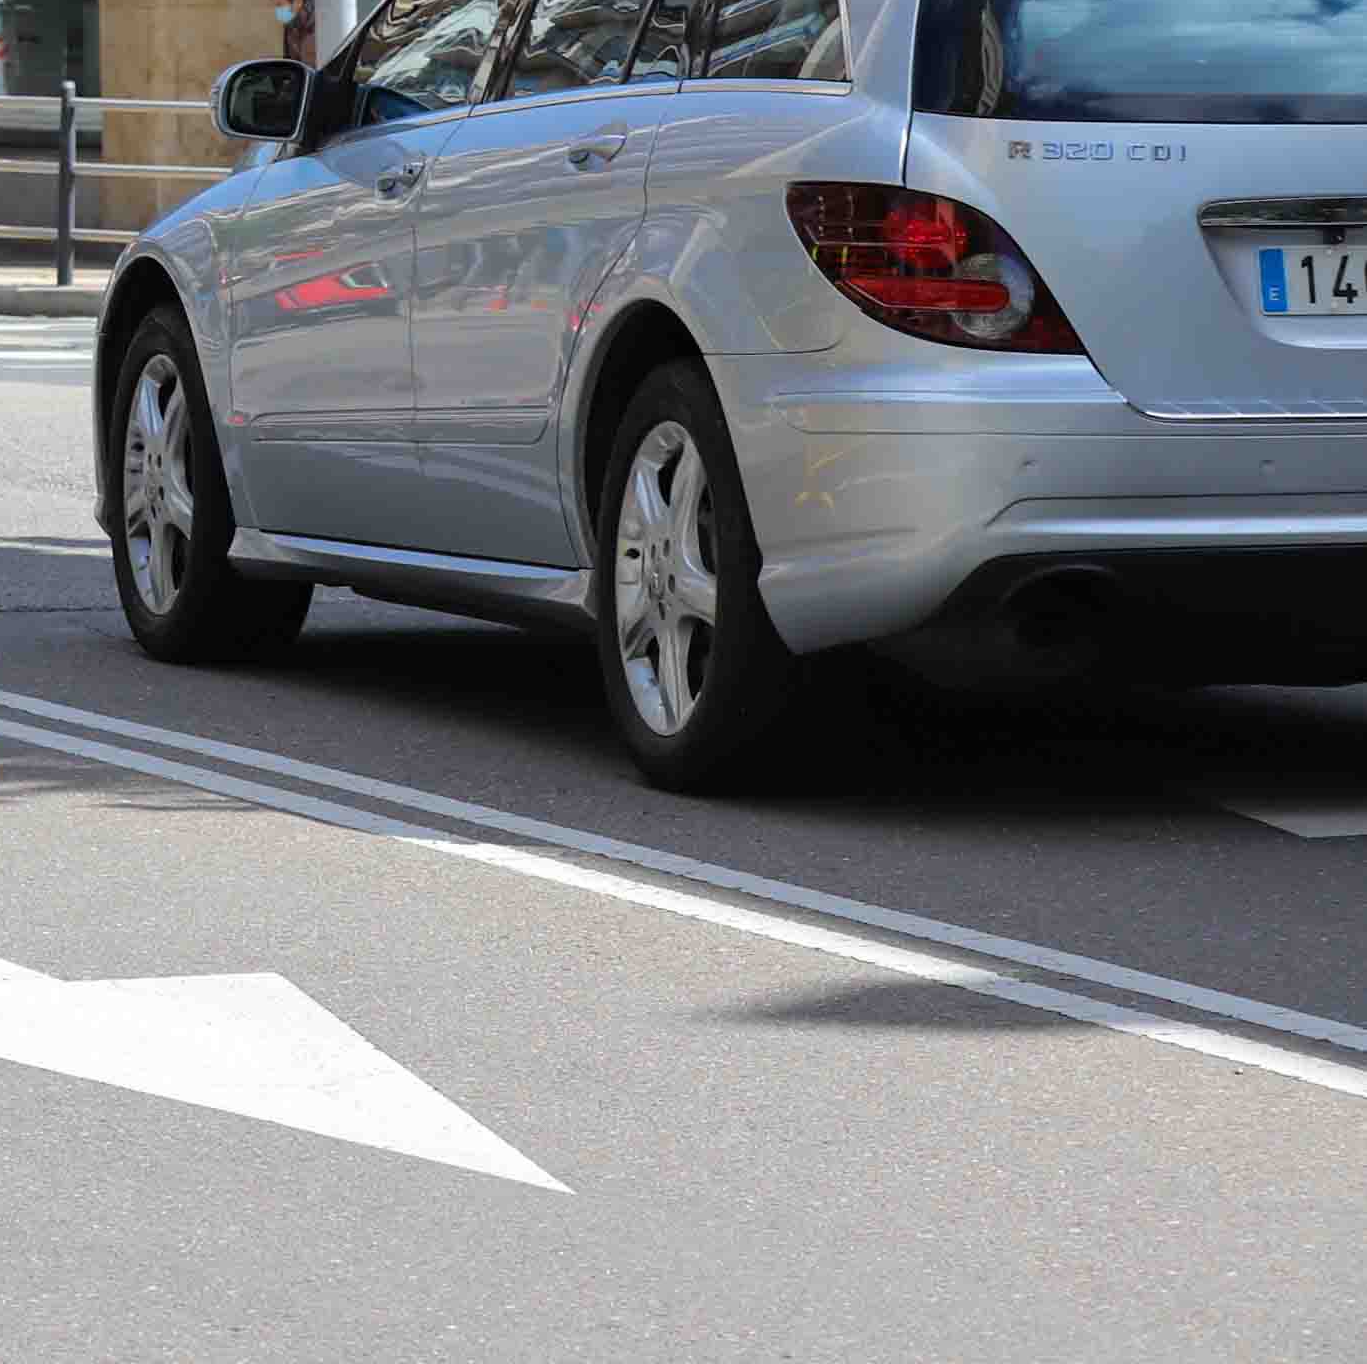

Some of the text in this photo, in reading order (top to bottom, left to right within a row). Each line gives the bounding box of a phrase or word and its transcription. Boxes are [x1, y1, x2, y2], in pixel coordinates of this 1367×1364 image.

[1008, 140, 1033, 160] R
[1041, 140, 1115, 161] 320
[1301, 255, 1367, 304] 14
